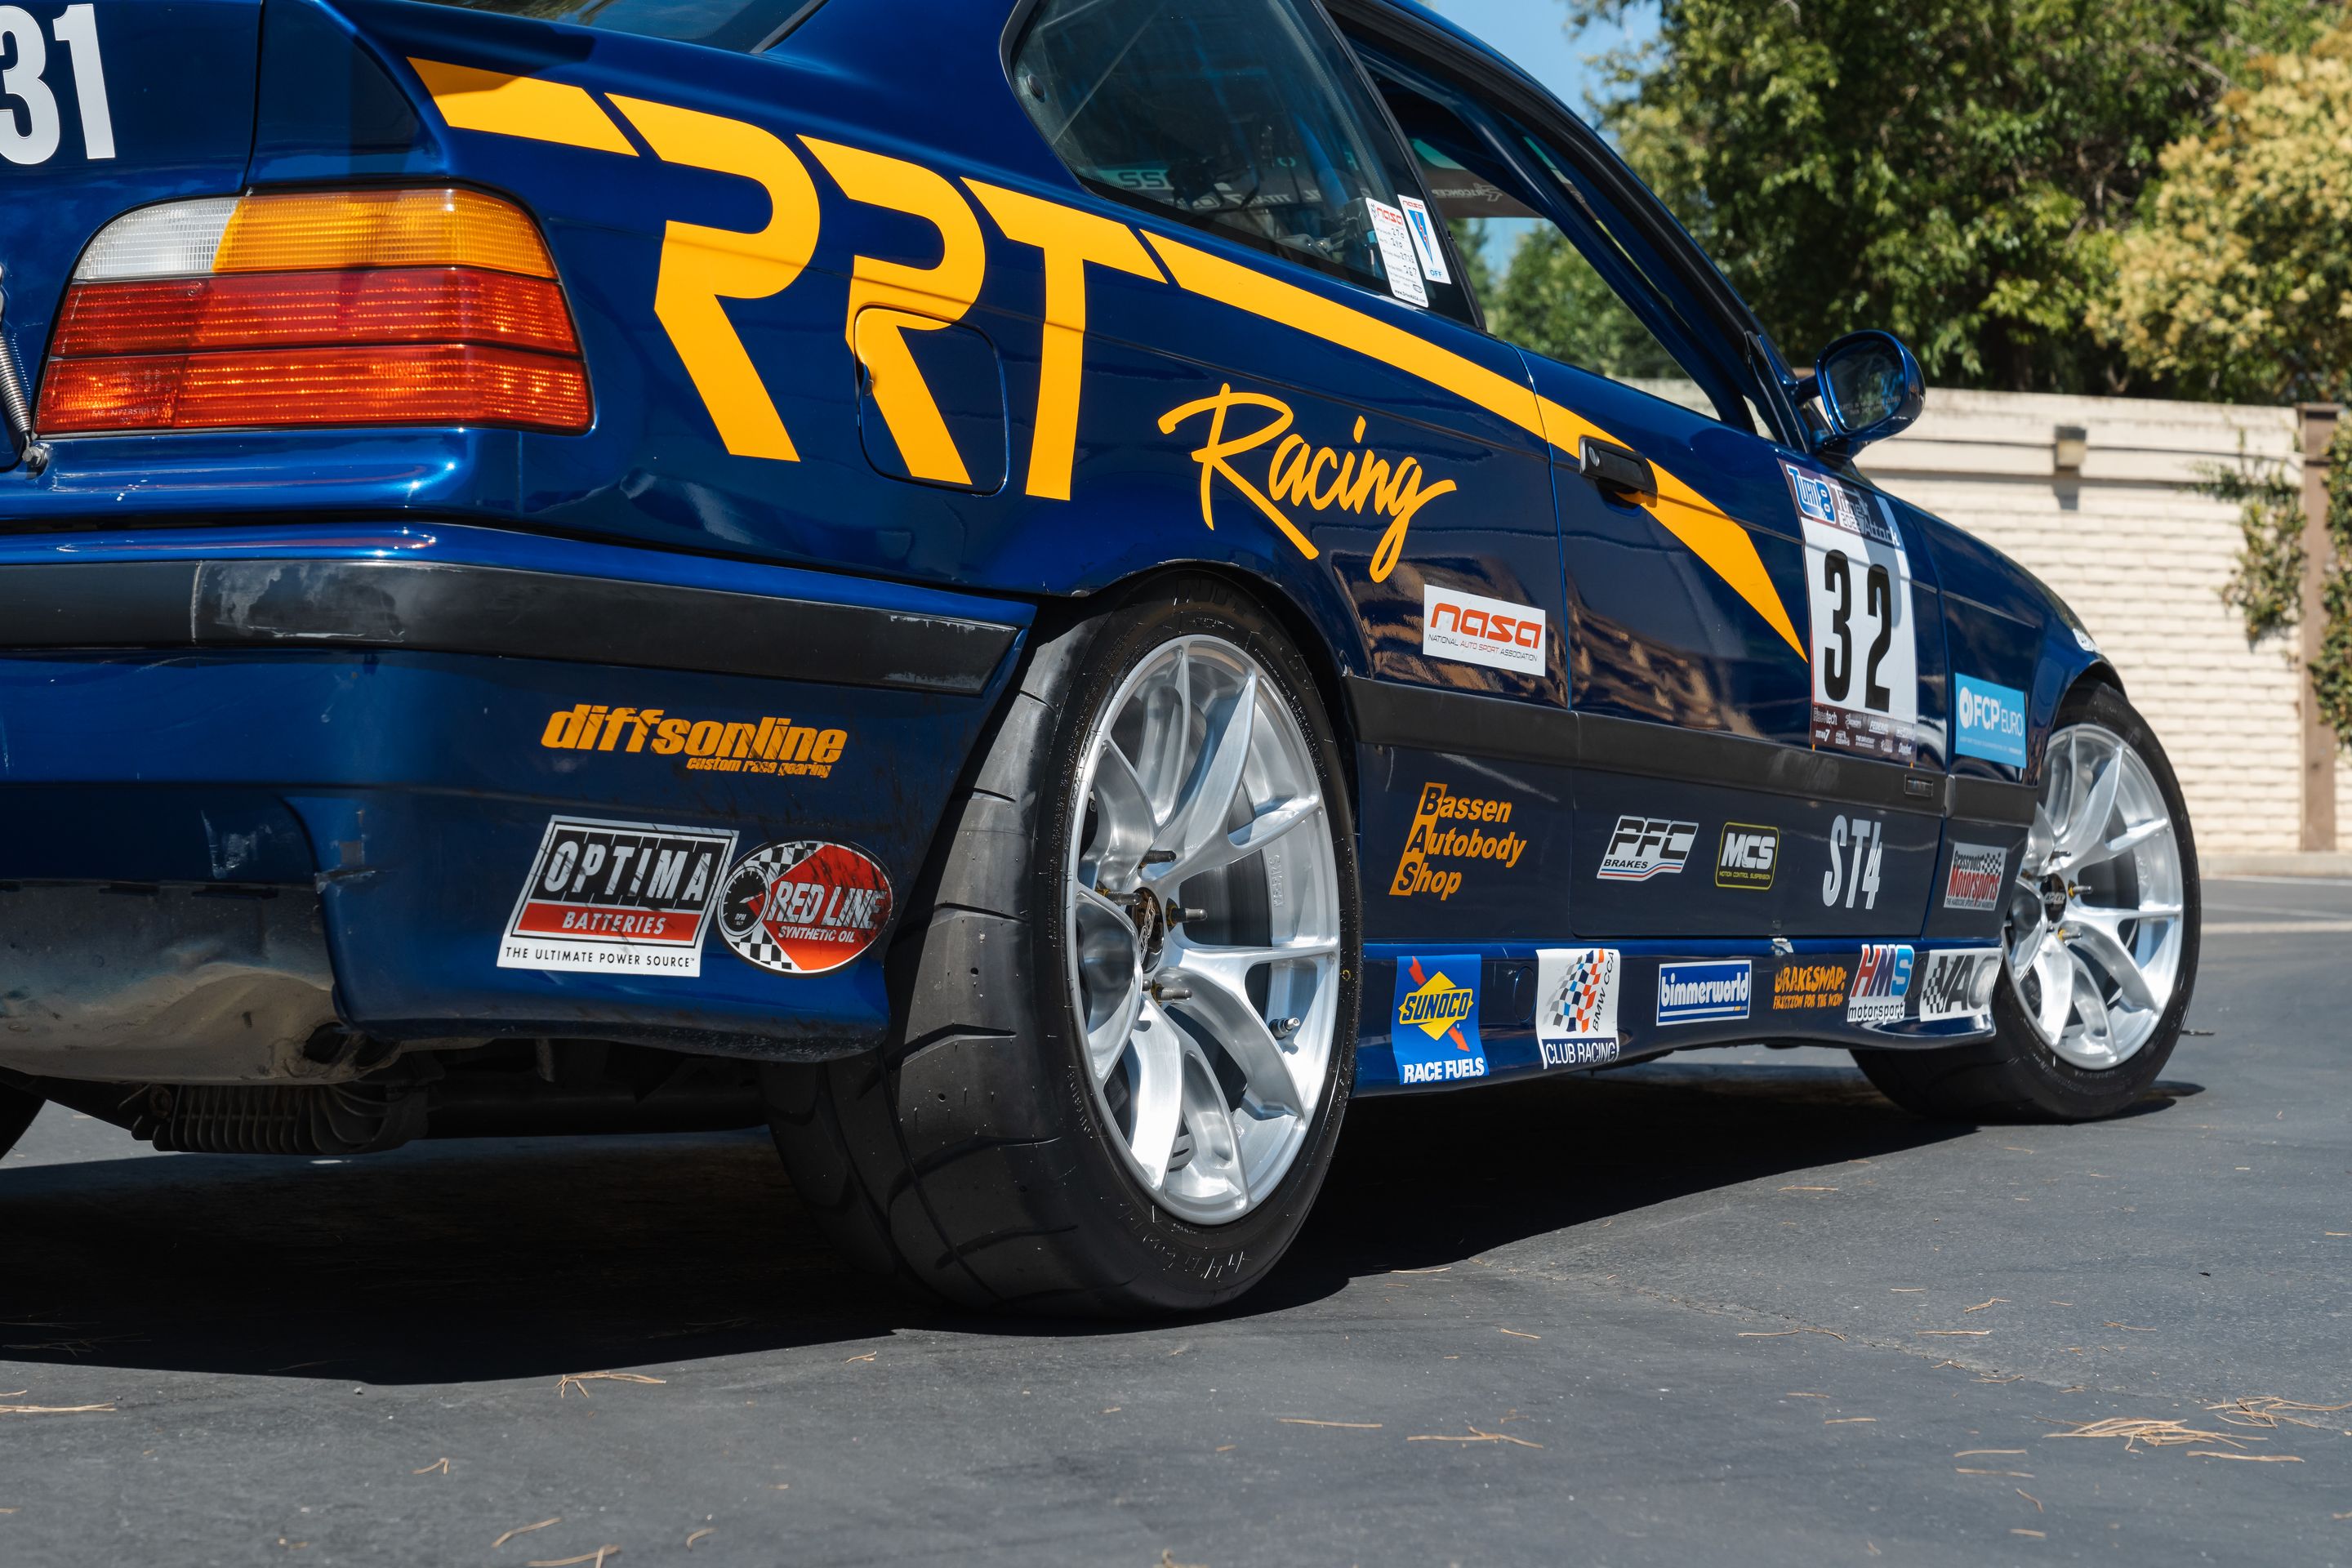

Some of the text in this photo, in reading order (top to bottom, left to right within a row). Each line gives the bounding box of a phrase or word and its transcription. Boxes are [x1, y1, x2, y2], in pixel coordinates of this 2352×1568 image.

[0, 3, 115, 165] 31
[1429, 270, 1442, 278] OFF
[604, 92, 1168, 501] RRT
[1158, 383, 1457, 582] Racing
[1428, 634, 1538, 662] NATIONAL AUTO SPORT ASSOCIATION
[1824, 549, 1892, 713] 32
[541, 703, 848, 764] diffsonline
[1973, 693, 2024, 737] FCP EURO
[686, 756, 832, 779] custom race gearing
[1420, 786, 1512, 823] Bassen
[1406, 823, 1527, 868] Autobody
[1608, 817, 1696, 858] PFC
[1720, 832, 1776, 870] MCS
[544, 840, 712, 902] OPTIMA
[1602, 858, 1649, 870] BRAKES
[1822, 814, 1883, 910] ST4
[1397, 862, 1463, 901] Shop
[1948, 864, 2001, 907] Motorsports
[562, 911, 667, 935] BATTERIES
[766, 880, 888, 929] RED LINE
[778, 925, 855, 943] SYNTHETIC OIL
[505, 947, 531, 960] THE
[535, 947, 595, 963] ULTIMATE
[599, 951, 641, 965] POWER
[1851, 946, 1913, 998] HMS
[1402, 991, 1470, 1023] SUNOCO
[1592, 950, 1616, 1032] BMW CCA
[1660, 970, 1749, 1007] bimmerworld
[1804, 994, 1815, 1009] FOR
[1847, 1002, 1904, 1022] motorsport
[1403, 1057, 1485, 1084] RACE FUELS
[1545, 1040, 1616, 1065] CLUB RACING
